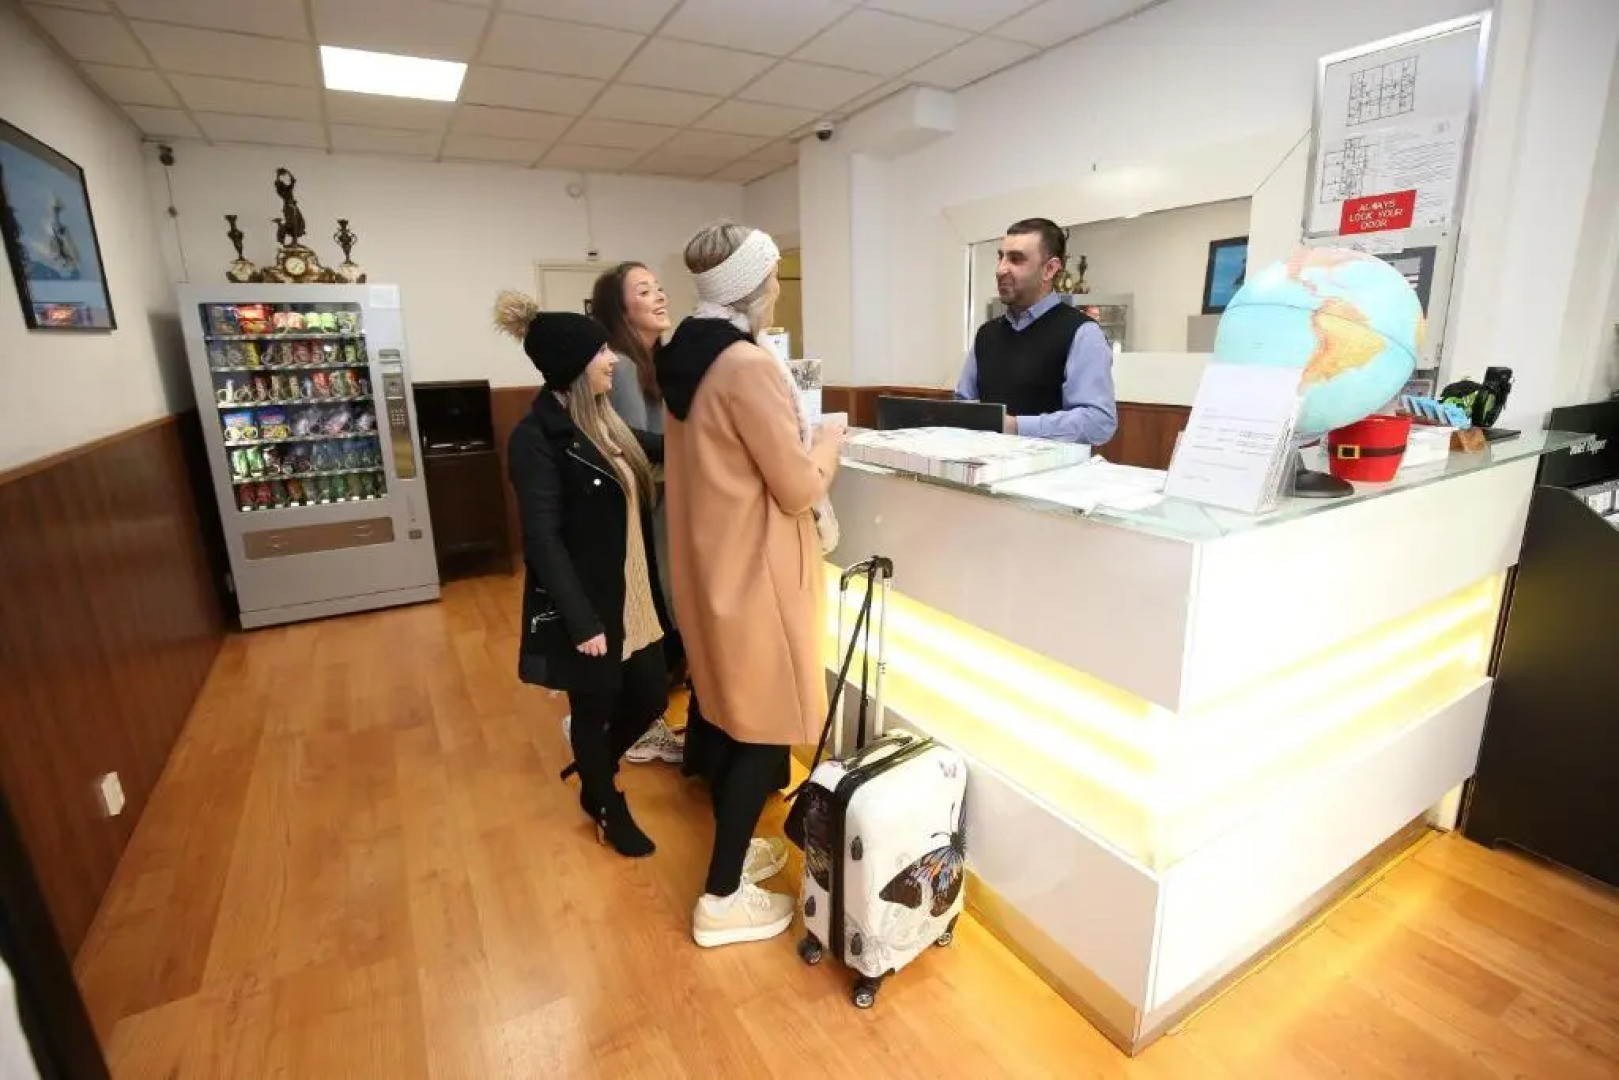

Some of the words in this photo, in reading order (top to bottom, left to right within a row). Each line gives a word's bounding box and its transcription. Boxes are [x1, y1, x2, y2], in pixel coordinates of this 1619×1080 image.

[1359, 200, 1396, 212] ALWAYS
[1349, 211, 1373, 222] LOCK
[1378, 208, 1404, 218] YOUR
[1360, 218, 1388, 230] DOOR
